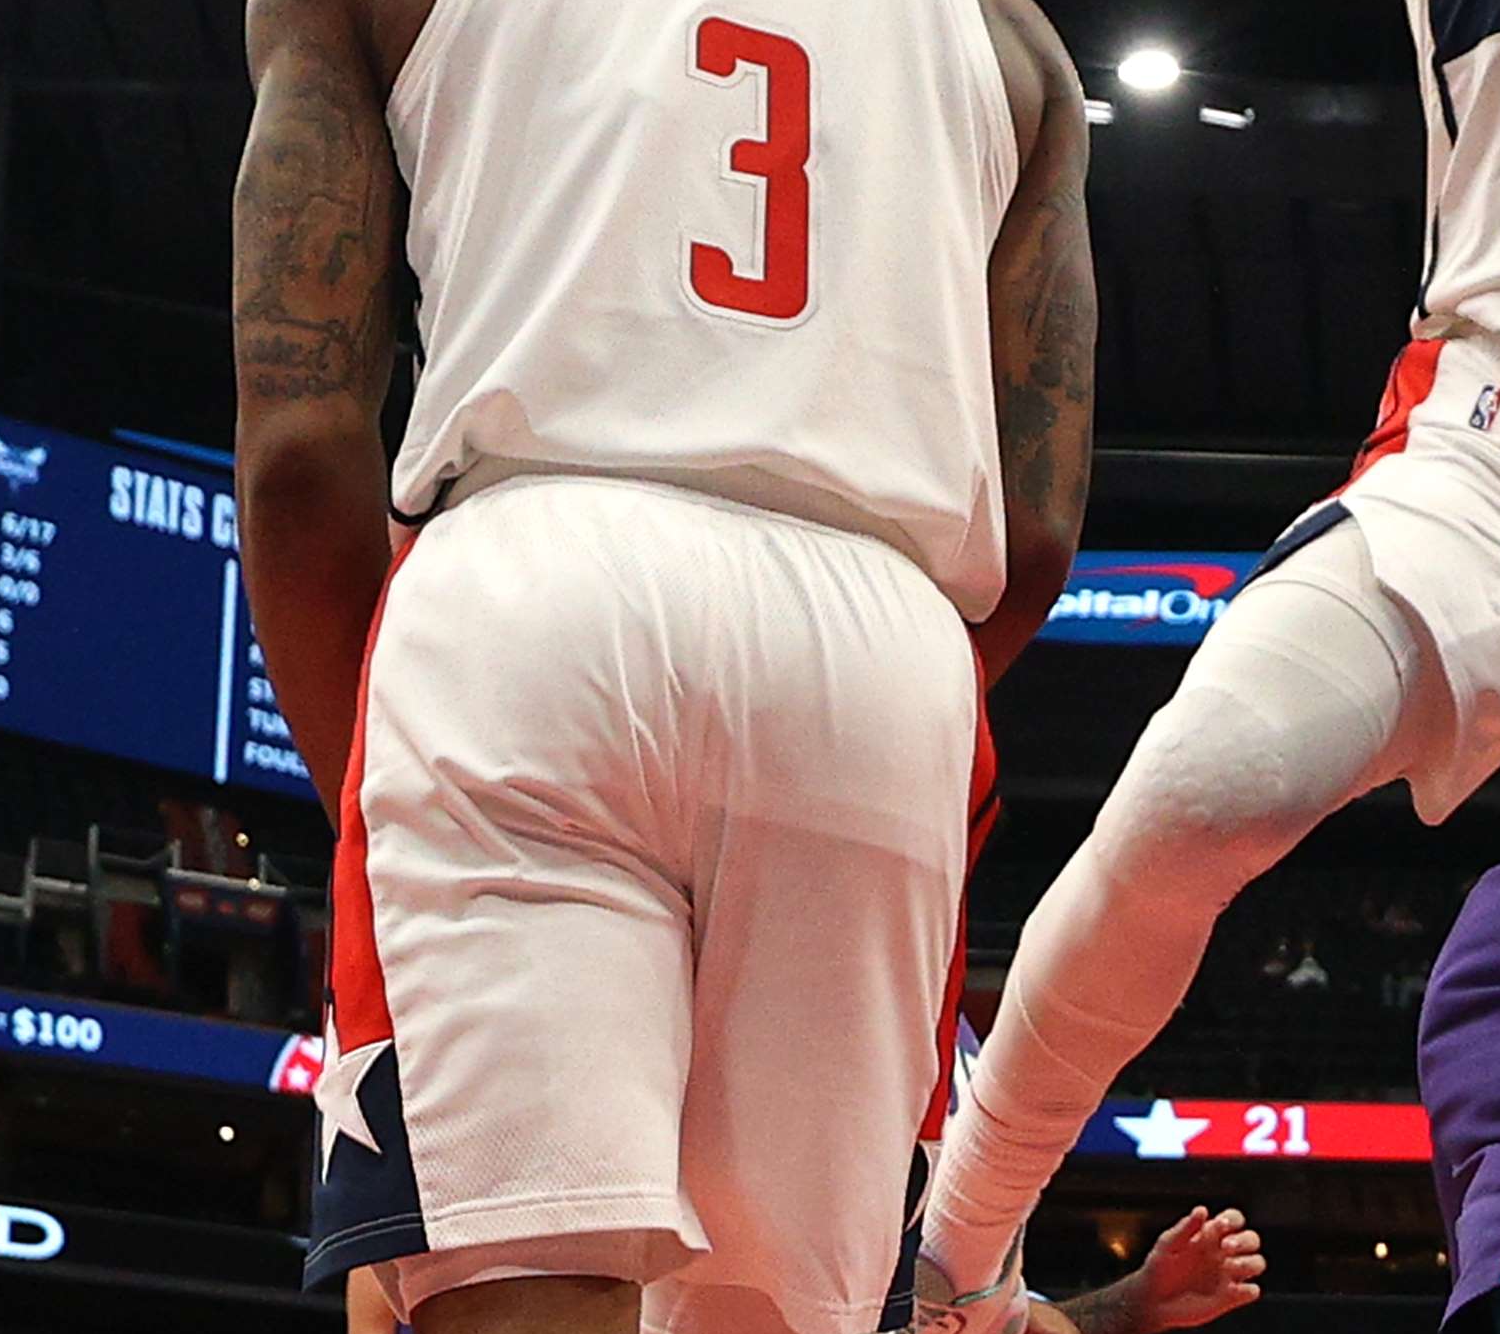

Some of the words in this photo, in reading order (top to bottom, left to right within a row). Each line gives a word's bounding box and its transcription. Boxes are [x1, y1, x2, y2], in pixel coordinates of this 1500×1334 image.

[682, 15, 817, 327] 3
[109, 464, 205, 541] STATS
[12, 1006, 103, 1053] $100
[1242, 1105, 1312, 1155] 21
